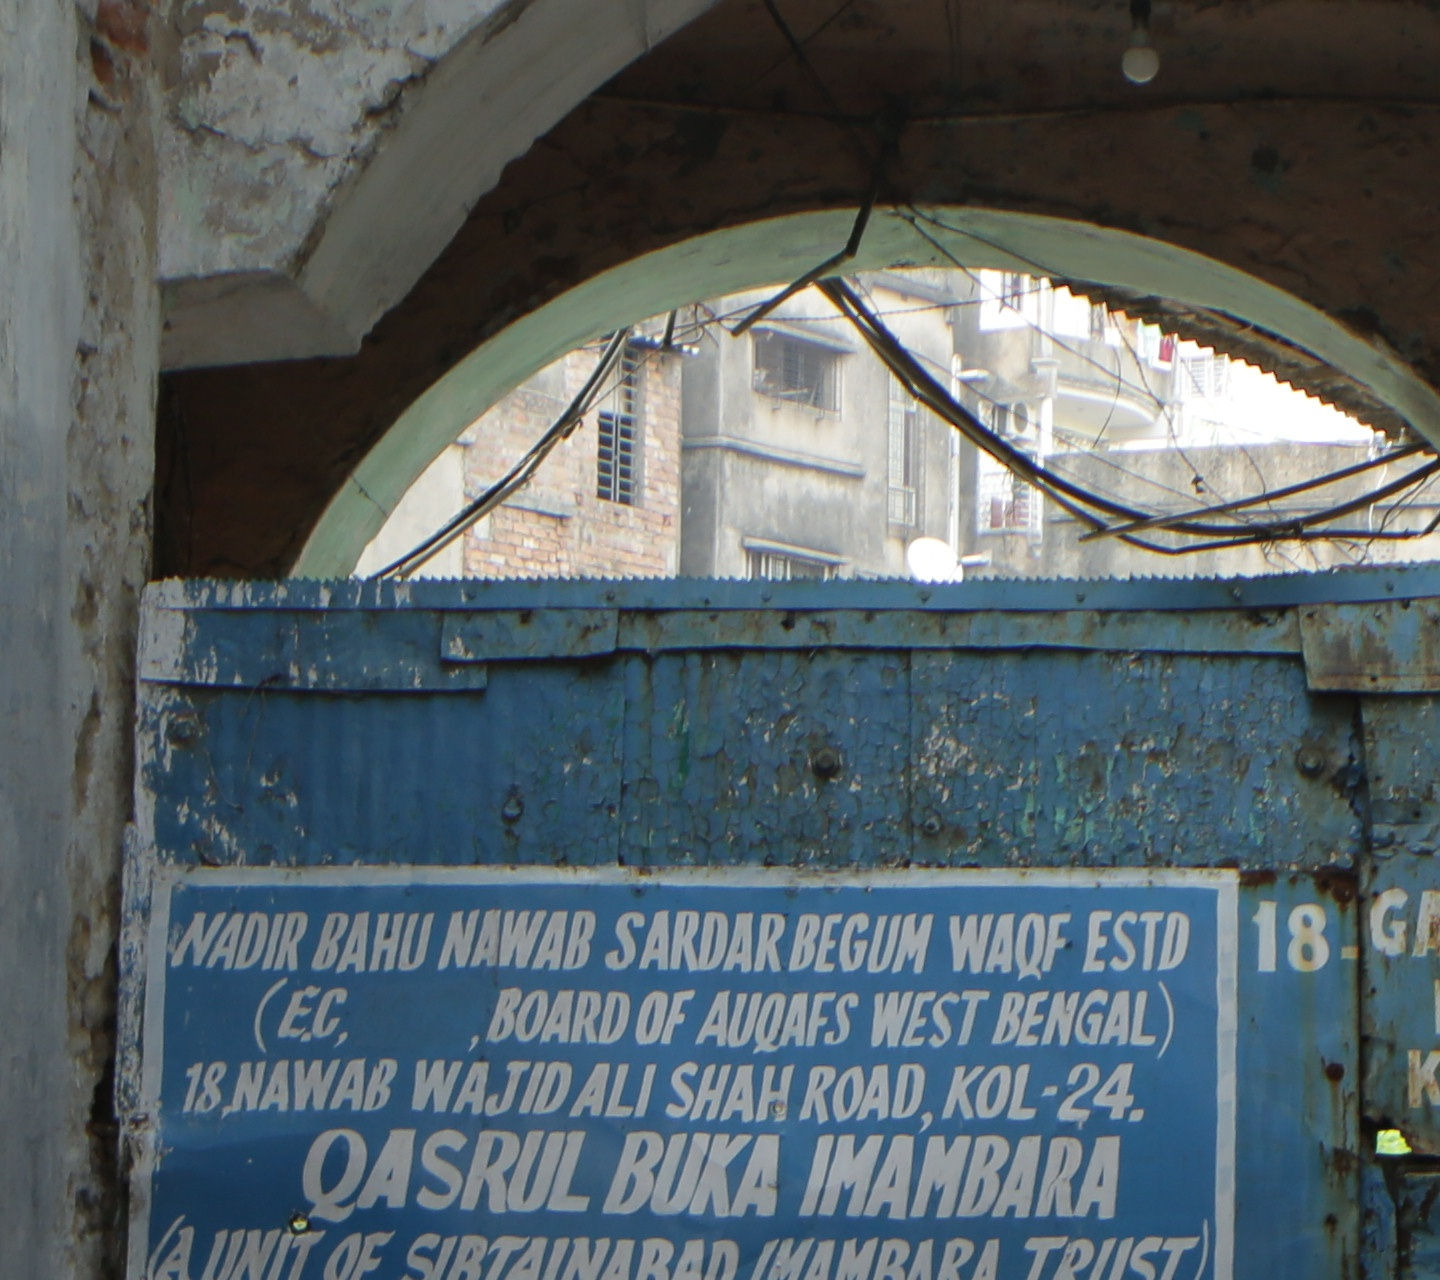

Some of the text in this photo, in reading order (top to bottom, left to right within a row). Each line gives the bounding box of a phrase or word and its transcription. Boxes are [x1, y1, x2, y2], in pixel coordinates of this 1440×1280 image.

[171, 909, 1190, 981] NADIR BAHU NAWAB SARDAR BEGUM WAQF ESTD
[636, 990, 695, 1045] OF
[696, 990, 858, 1053] AUQAFS
[871, 990, 989, 1047] WEST
[992, 981, 1174, 1060] BENGAL)
[412, 1059, 574, 1115] WAJID
[570, 1062, 657, 1117] ALI
[666, 1062, 794, 1123] SHAH
[302, 1128, 1121, 1222] QASRUL BUKA IMAMBARA
